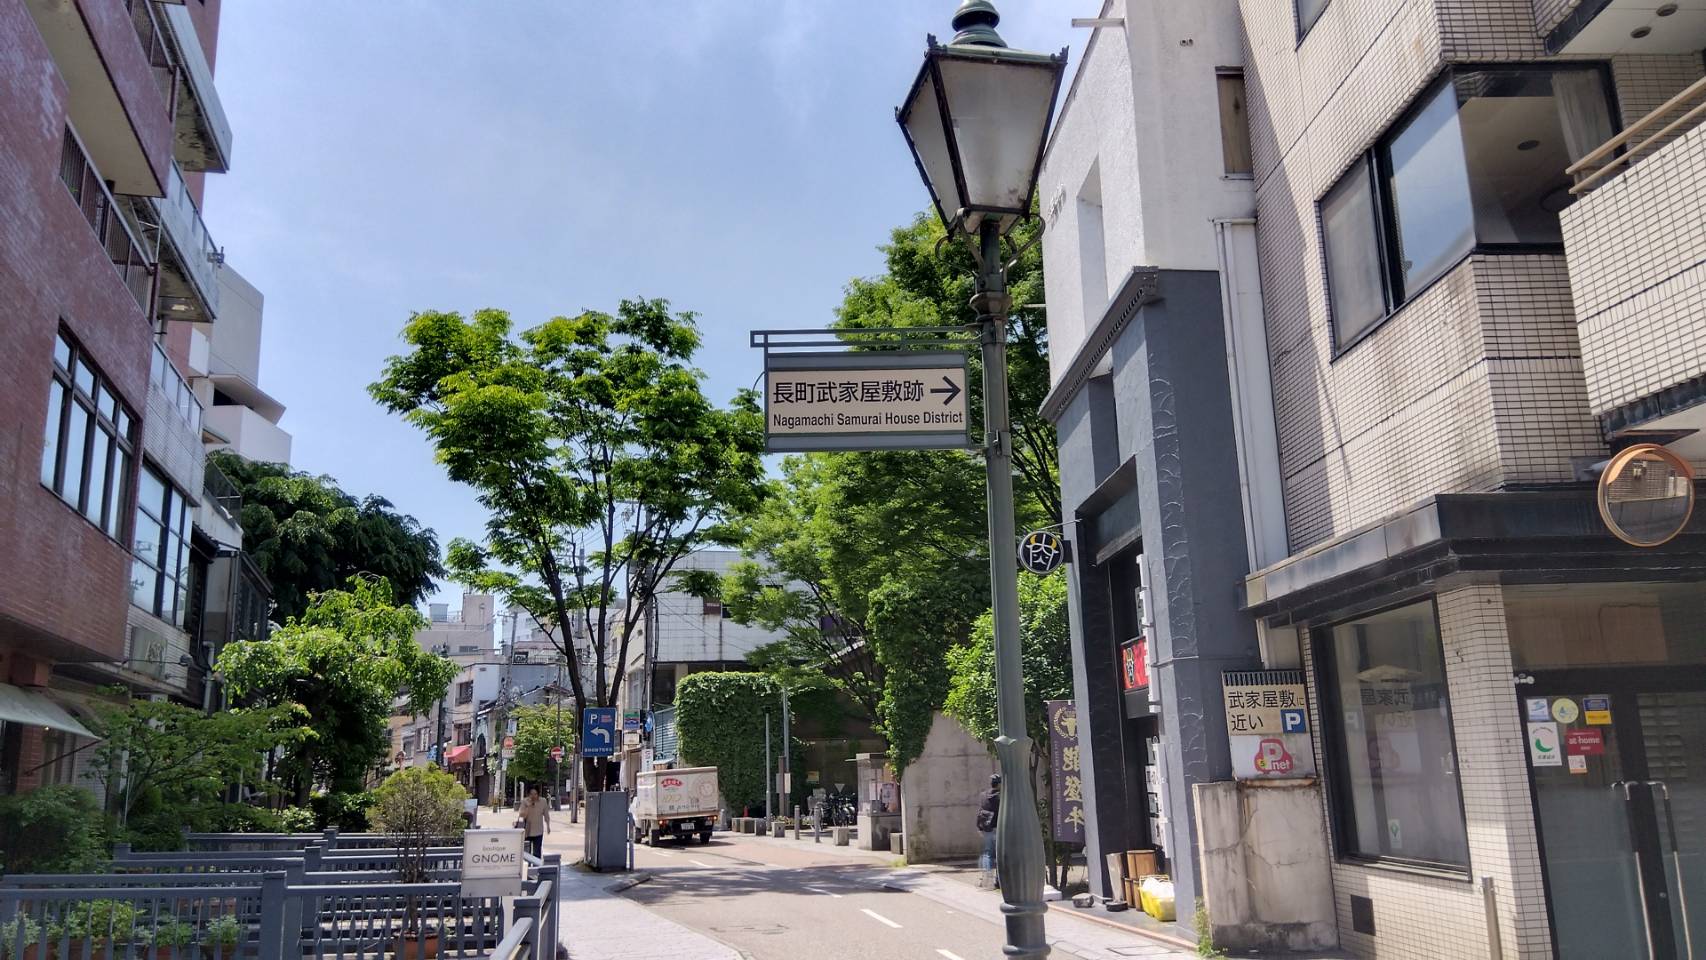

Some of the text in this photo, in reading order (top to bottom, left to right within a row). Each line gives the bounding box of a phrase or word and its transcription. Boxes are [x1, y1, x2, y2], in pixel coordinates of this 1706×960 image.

[773, 380, 924, 404] 長町武家屋敷跡
[773, 411, 963, 429] Nagamachi Samurai House District
[1228, 689, 1305, 709] 武家屋敷に
[590, 714, 598, 725] P
[1231, 714, 1264, 731] 近い
[1285, 712, 1301, 731] P
[471, 853, 516, 864] GNOME
